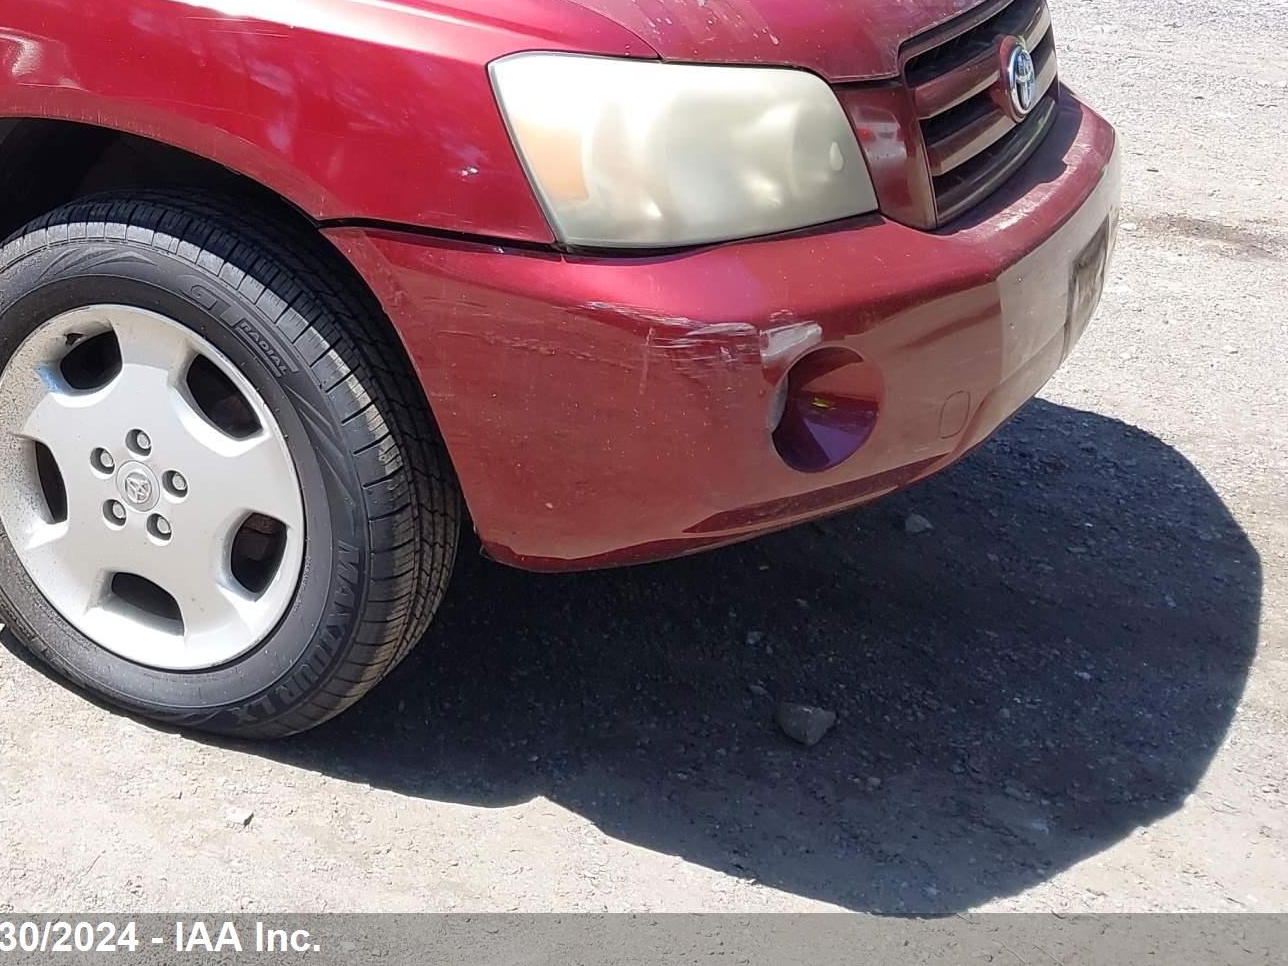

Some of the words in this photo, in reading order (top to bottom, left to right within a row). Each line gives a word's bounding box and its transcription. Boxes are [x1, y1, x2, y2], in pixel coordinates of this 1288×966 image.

[179, 284, 248, 328] GT
[239, 321, 289, 375] RADIAL
[276, 539, 361, 706] MAXTOUR
